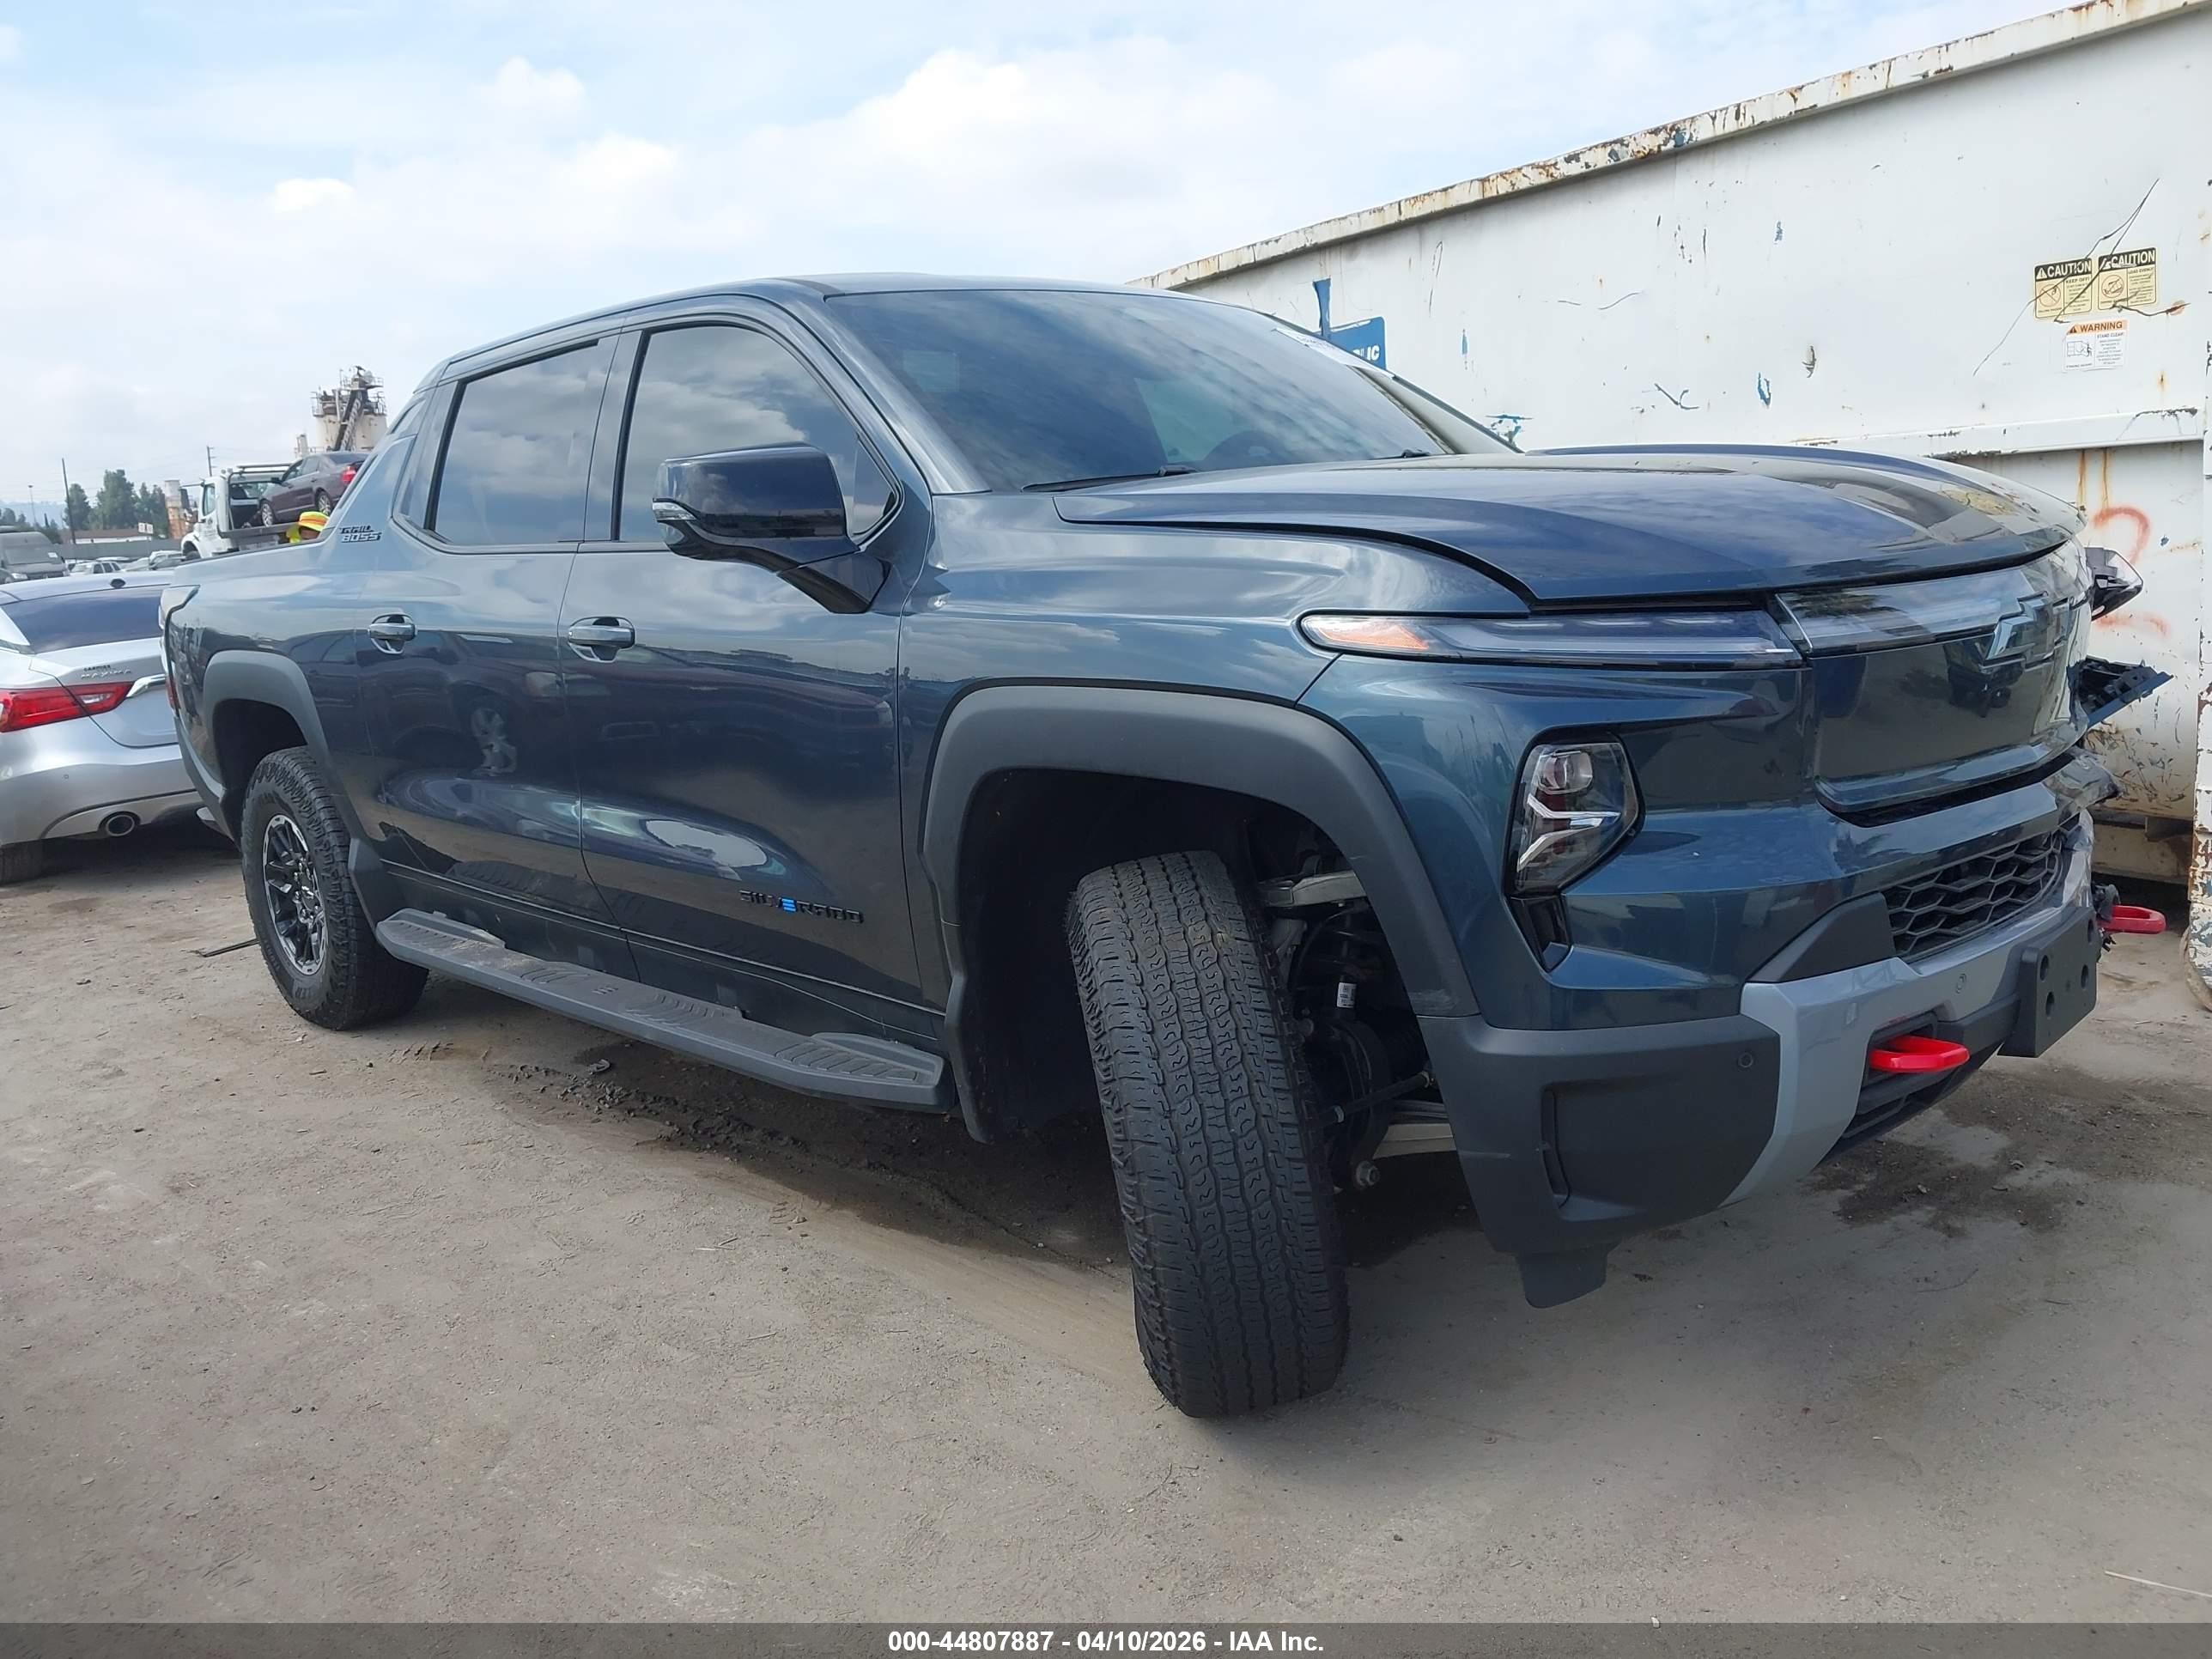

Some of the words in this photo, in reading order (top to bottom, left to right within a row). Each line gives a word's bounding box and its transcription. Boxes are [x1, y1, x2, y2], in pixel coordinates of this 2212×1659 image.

[2111, 250, 2155, 269] CAUTION
[2047, 261, 2092, 278] CAUTION
[2080, 321, 2123, 333] WARNING
[338, 525, 374, 535] TRAIL
[342, 532, 383, 544] BOSS
[81, 669, 131, 679] MAXIMA
[738, 889, 865, 925] SILVERADO
